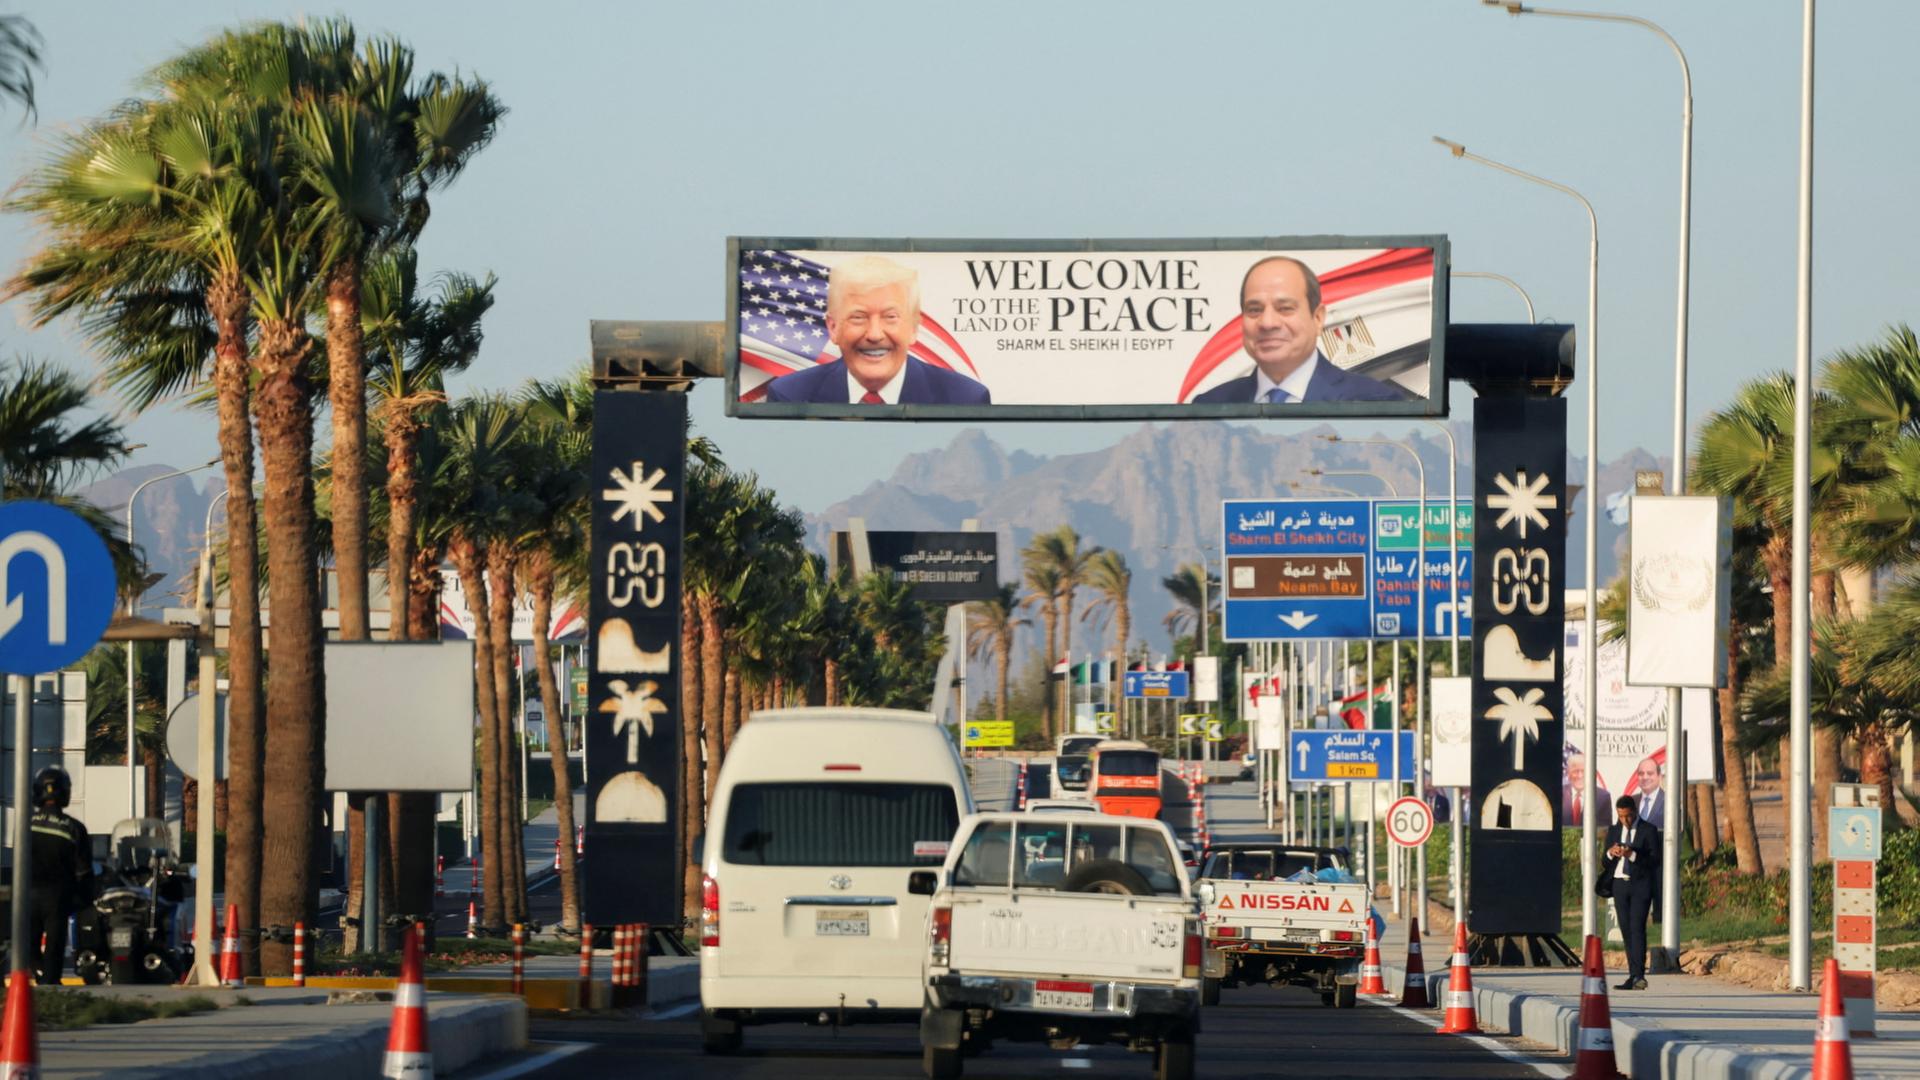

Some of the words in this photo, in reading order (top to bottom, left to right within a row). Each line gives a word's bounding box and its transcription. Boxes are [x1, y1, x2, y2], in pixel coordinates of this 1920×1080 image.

[964, 259, 1200, 290] WELCOME
[953, 299, 986, 315] TO
[990, 299, 1040, 315] THE
[1048, 296, 1212, 332] PEACE
[953, 317, 1007, 332] LAND
[1013, 317, 1040, 332] OF
[996, 338, 1045, 351] SHARM
[1049, 338, 1065, 351] EL
[1069, 338, 1119, 351] SHEIKH
[1131, 338, 1174, 351] EGYPT
[1238, 510, 1275, 531] الشيخ
[1281, 510, 1311, 529] شرم
[1318, 511, 1354, 529] مدينة
[1228, 533, 1271, 545] Sharm
[1274, 533, 1286, 545] El
[1290, 532, 1334, 545] Sheikh
[1337, 532, 1366, 547] City
[1283, 561, 1316, 578] نعمة
[1323, 559, 1352, 580] خليج
[1376, 556, 1403, 577] طابا
[947, 571, 979, 582] AIRPORT
[1330, 581, 1357, 595] Bay
[1378, 594, 1411, 606] Taba
[1325, 733, 1365, 750] السلام
[1599, 733, 1646, 743] ELCOME
[1328, 750, 1359, 761] Salam
[1608, 744, 1648, 753] PEACE
[1349, 766, 1366, 776] km
[1394, 811, 1425, 833] 60
[1241, 894, 1330, 911] NISSAN
